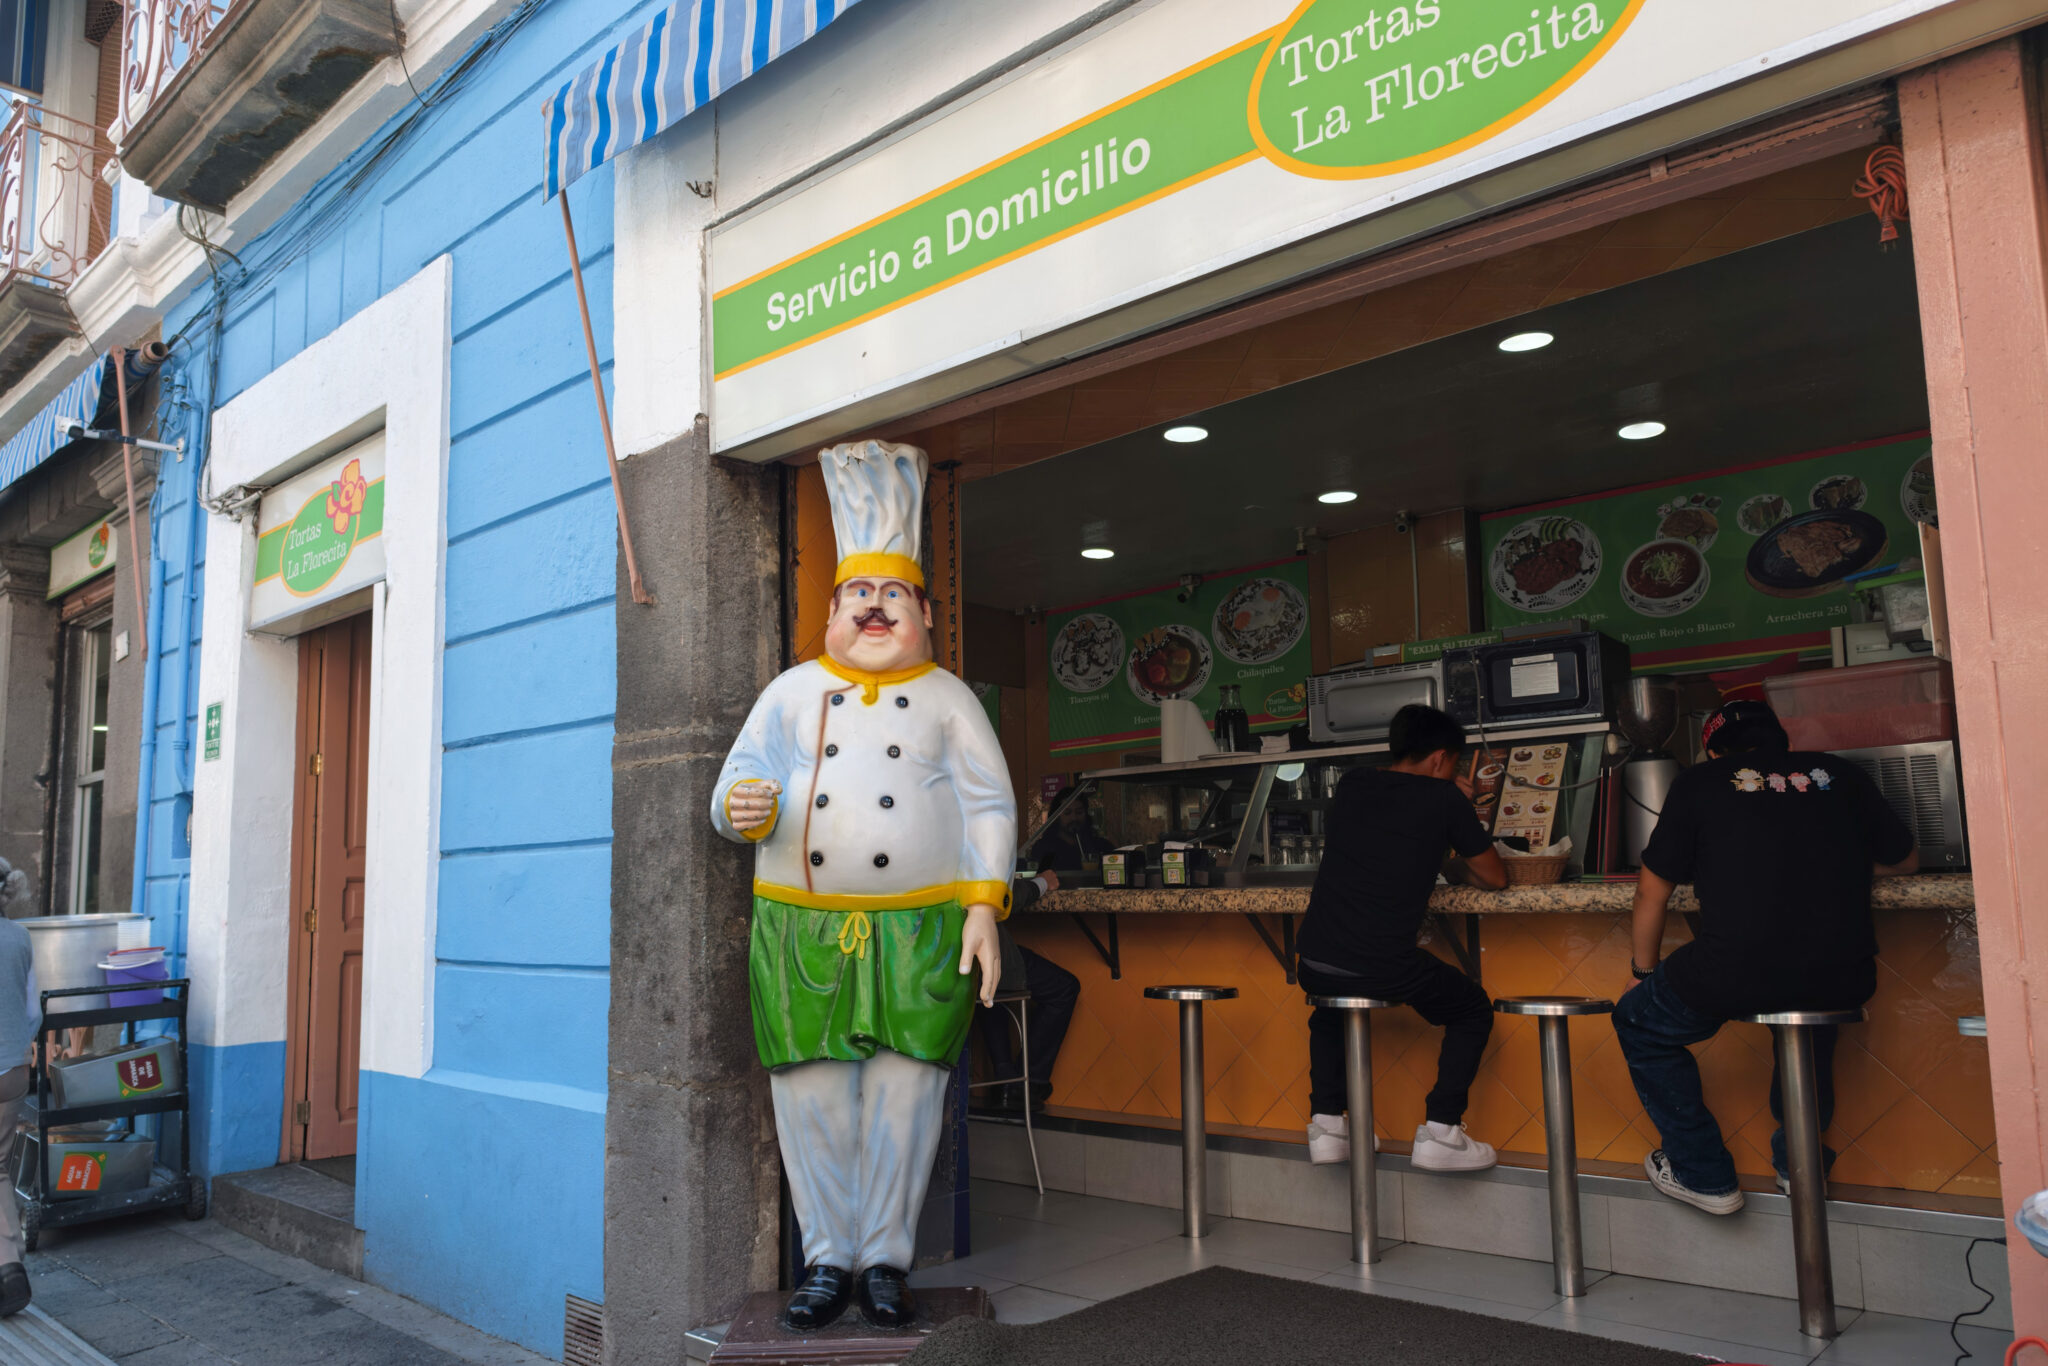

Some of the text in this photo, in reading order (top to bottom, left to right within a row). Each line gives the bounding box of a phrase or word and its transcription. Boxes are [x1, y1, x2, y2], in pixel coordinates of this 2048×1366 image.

[1280, 0, 1441, 87] Tortas
[1291, 2, 1605, 153] La Florecita
[766, 136, 1151, 332] Servicio a Domicilio
[289, 523, 322, 551] Tortas
[287, 540, 347, 581] La Florecita
[1766, 604, 1848, 625] Arrachera 250
[1621, 620, 1735, 643] Pozole Rojo o Blanco
[1442, 641, 1455, 650] SU
[1237, 665, 1285, 679] Chilaquiles
[145, 1061, 154, 1079] AGUA
[66, 1166, 76, 1184] AGUA
